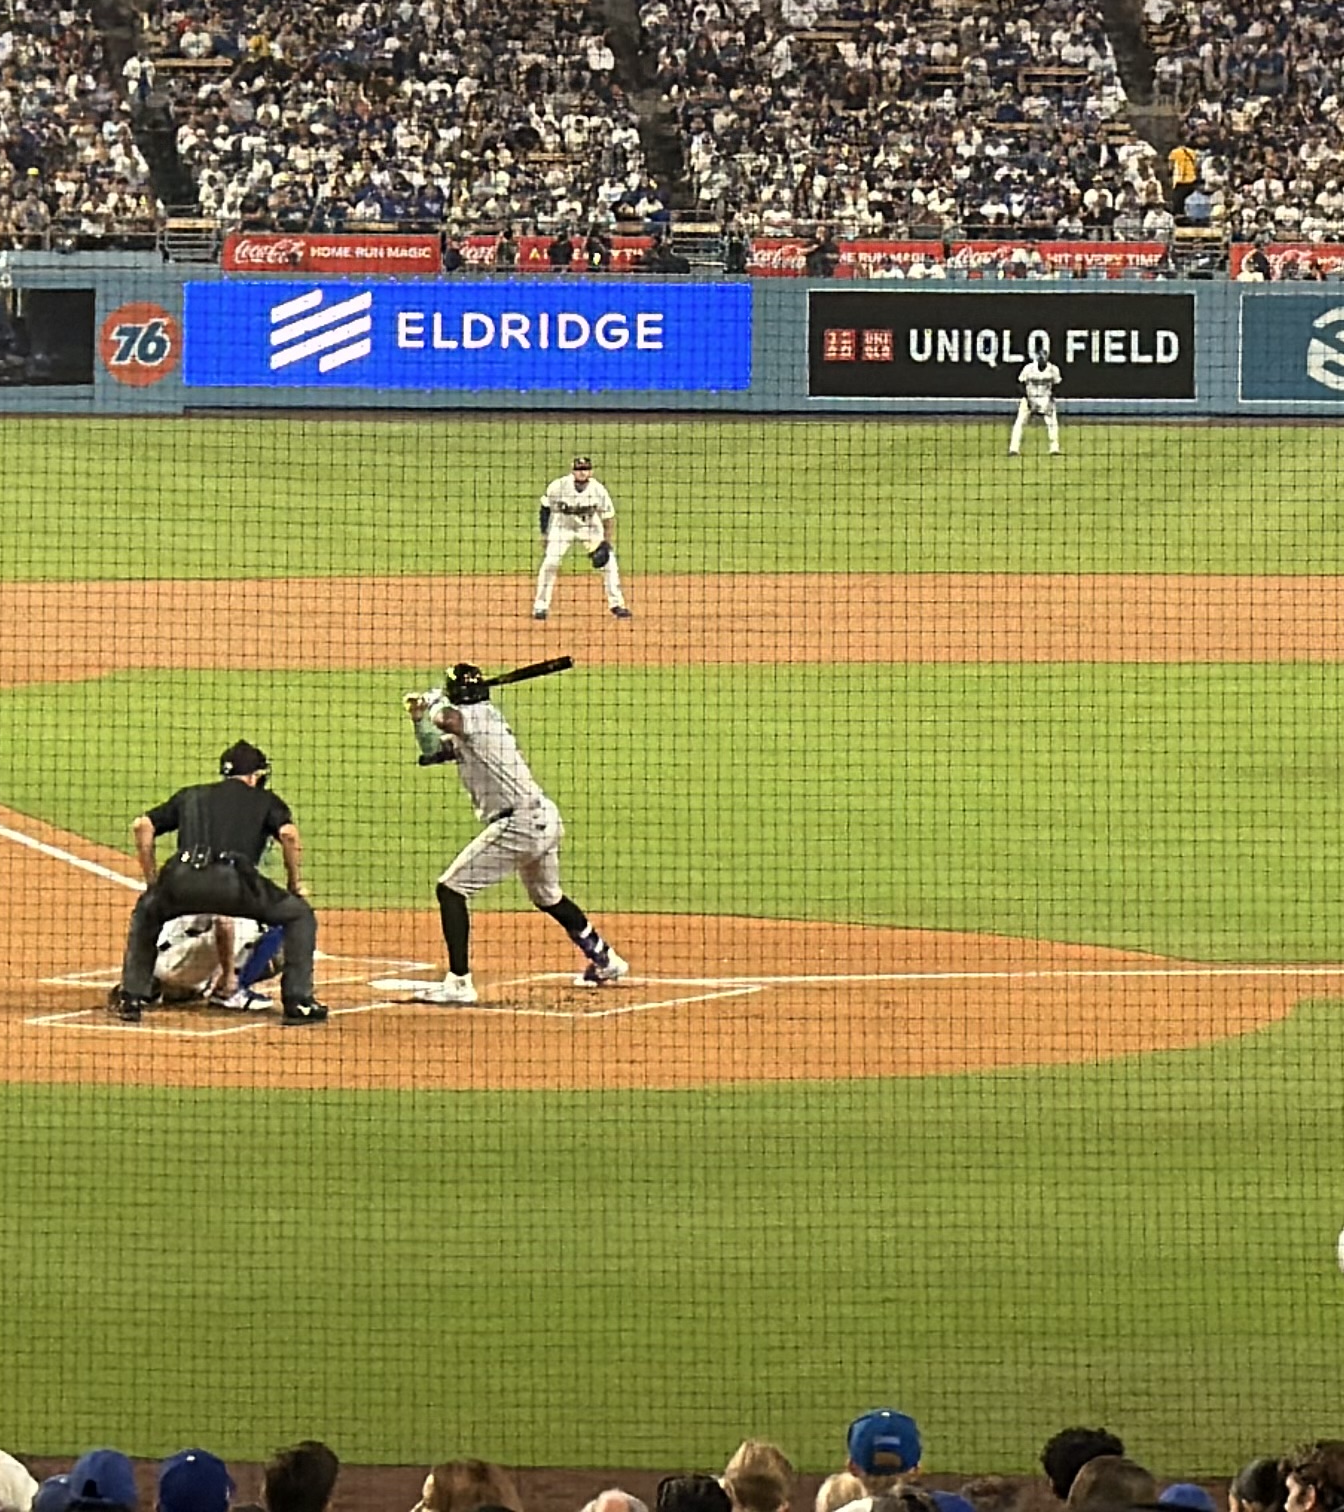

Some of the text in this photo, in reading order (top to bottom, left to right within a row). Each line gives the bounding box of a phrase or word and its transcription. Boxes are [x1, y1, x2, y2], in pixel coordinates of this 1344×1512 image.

[310, 246, 352, 258] HOME
[355, 246, 382, 258] RUN
[387, 246, 431, 259] MAGIC
[110, 318, 171, 365] 76
[397, 313, 664, 350] ELDRIDGE
[909, 329, 1180, 367] UNIQLO FIELD
